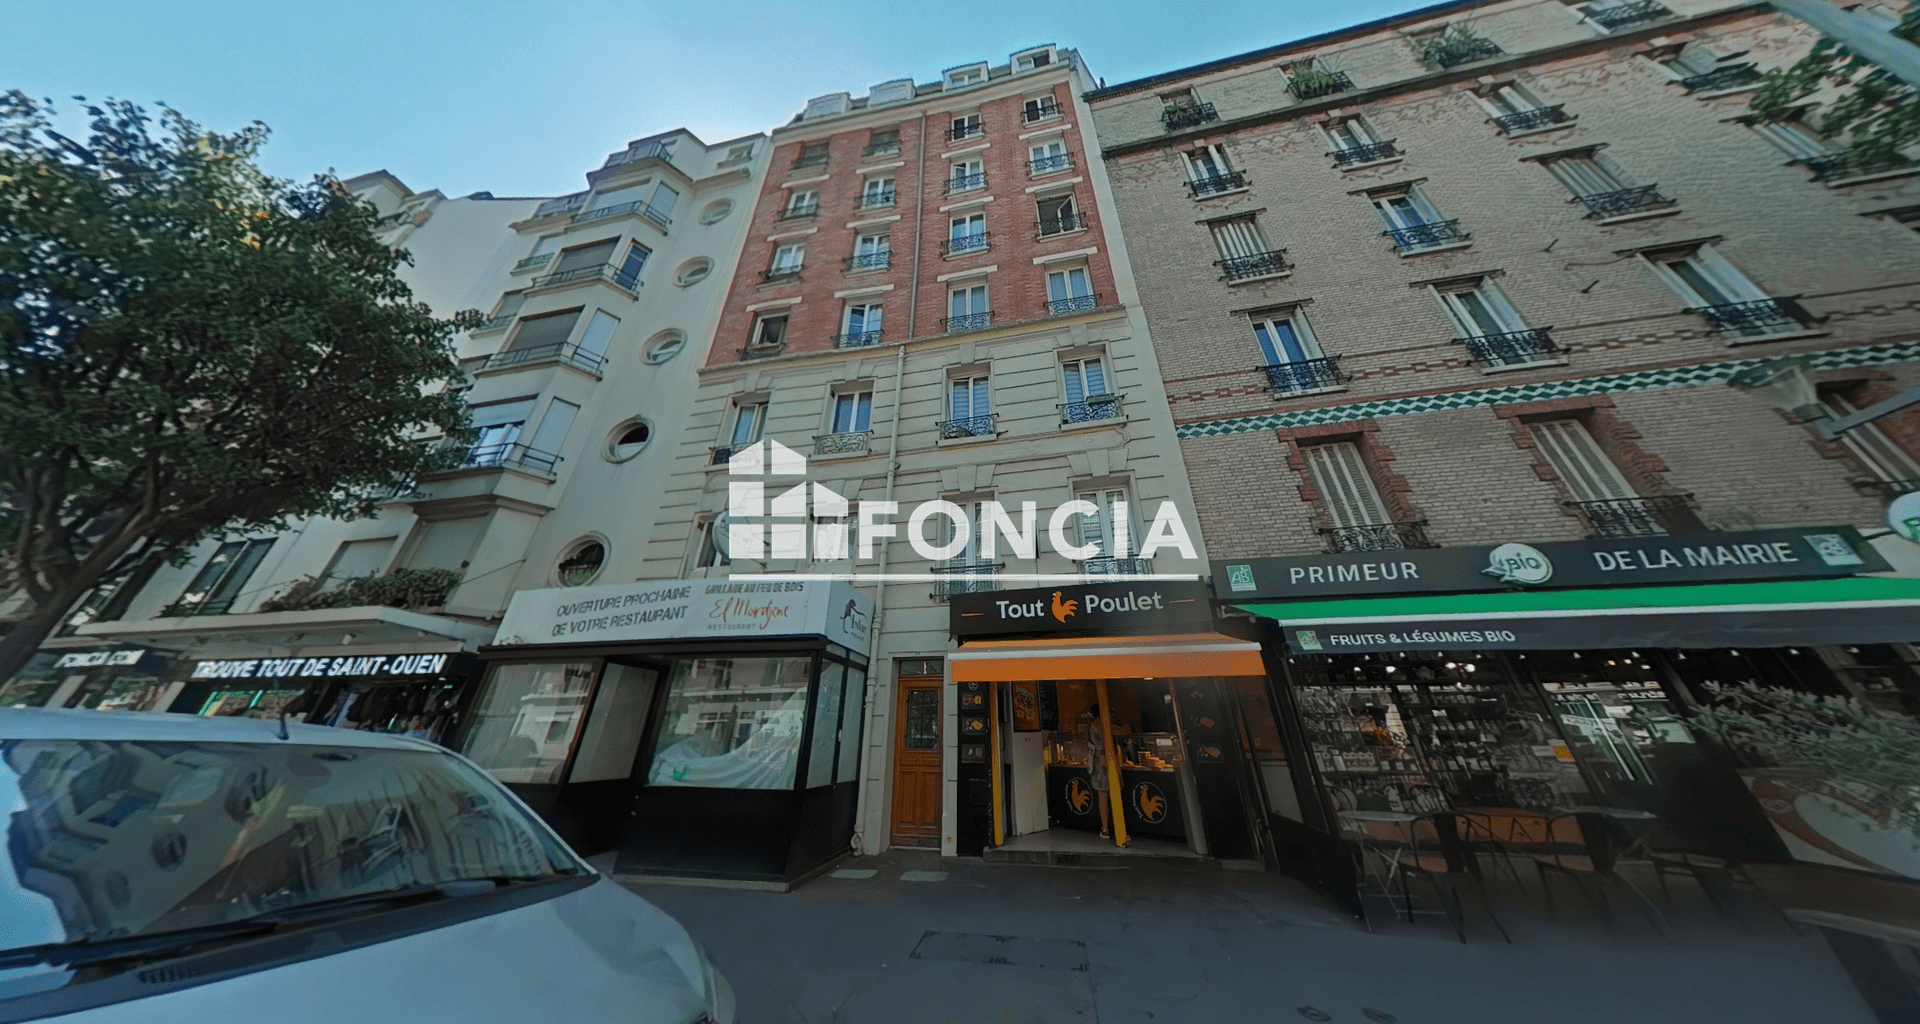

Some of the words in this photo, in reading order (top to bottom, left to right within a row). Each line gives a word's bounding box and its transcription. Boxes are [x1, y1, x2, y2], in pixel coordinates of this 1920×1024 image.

[1593, 551, 1644, 571] DE
[1639, 549, 1683, 569] LA
[1683, 542, 1800, 567] MAIRIE
[1289, 561, 1420, 585] PRIMEUR
[705, 584, 744, 594] GRILLADE
[744, 583, 756, 593] AU
[784, 581, 804, 592] BOIS
[556, 596, 622, 617] OUVERTURE
[622, 586, 692, 607] PROCHAINE
[709, 597, 734, 622] El
[996, 600, 1044, 620] Tout
[1085, 592, 1163, 614] Poulet
[551, 622, 568, 637] DE
[570, 616, 609, 634] VOTRE
[609, 605, 688, 628] RESTAURANT
[1329, 634, 1386, 645] FRUITS
[1389, 633, 1400, 643] &
[1402, 629, 1483, 643] LÉGUMES
[1486, 630, 1516, 642] BIO
[190, 660, 257, 679] TROUVE
[255, 658, 304, 677] TOUT
[300, 658, 329, 677] DE
[327, 654, 447, 676] SAINT-OUEN
